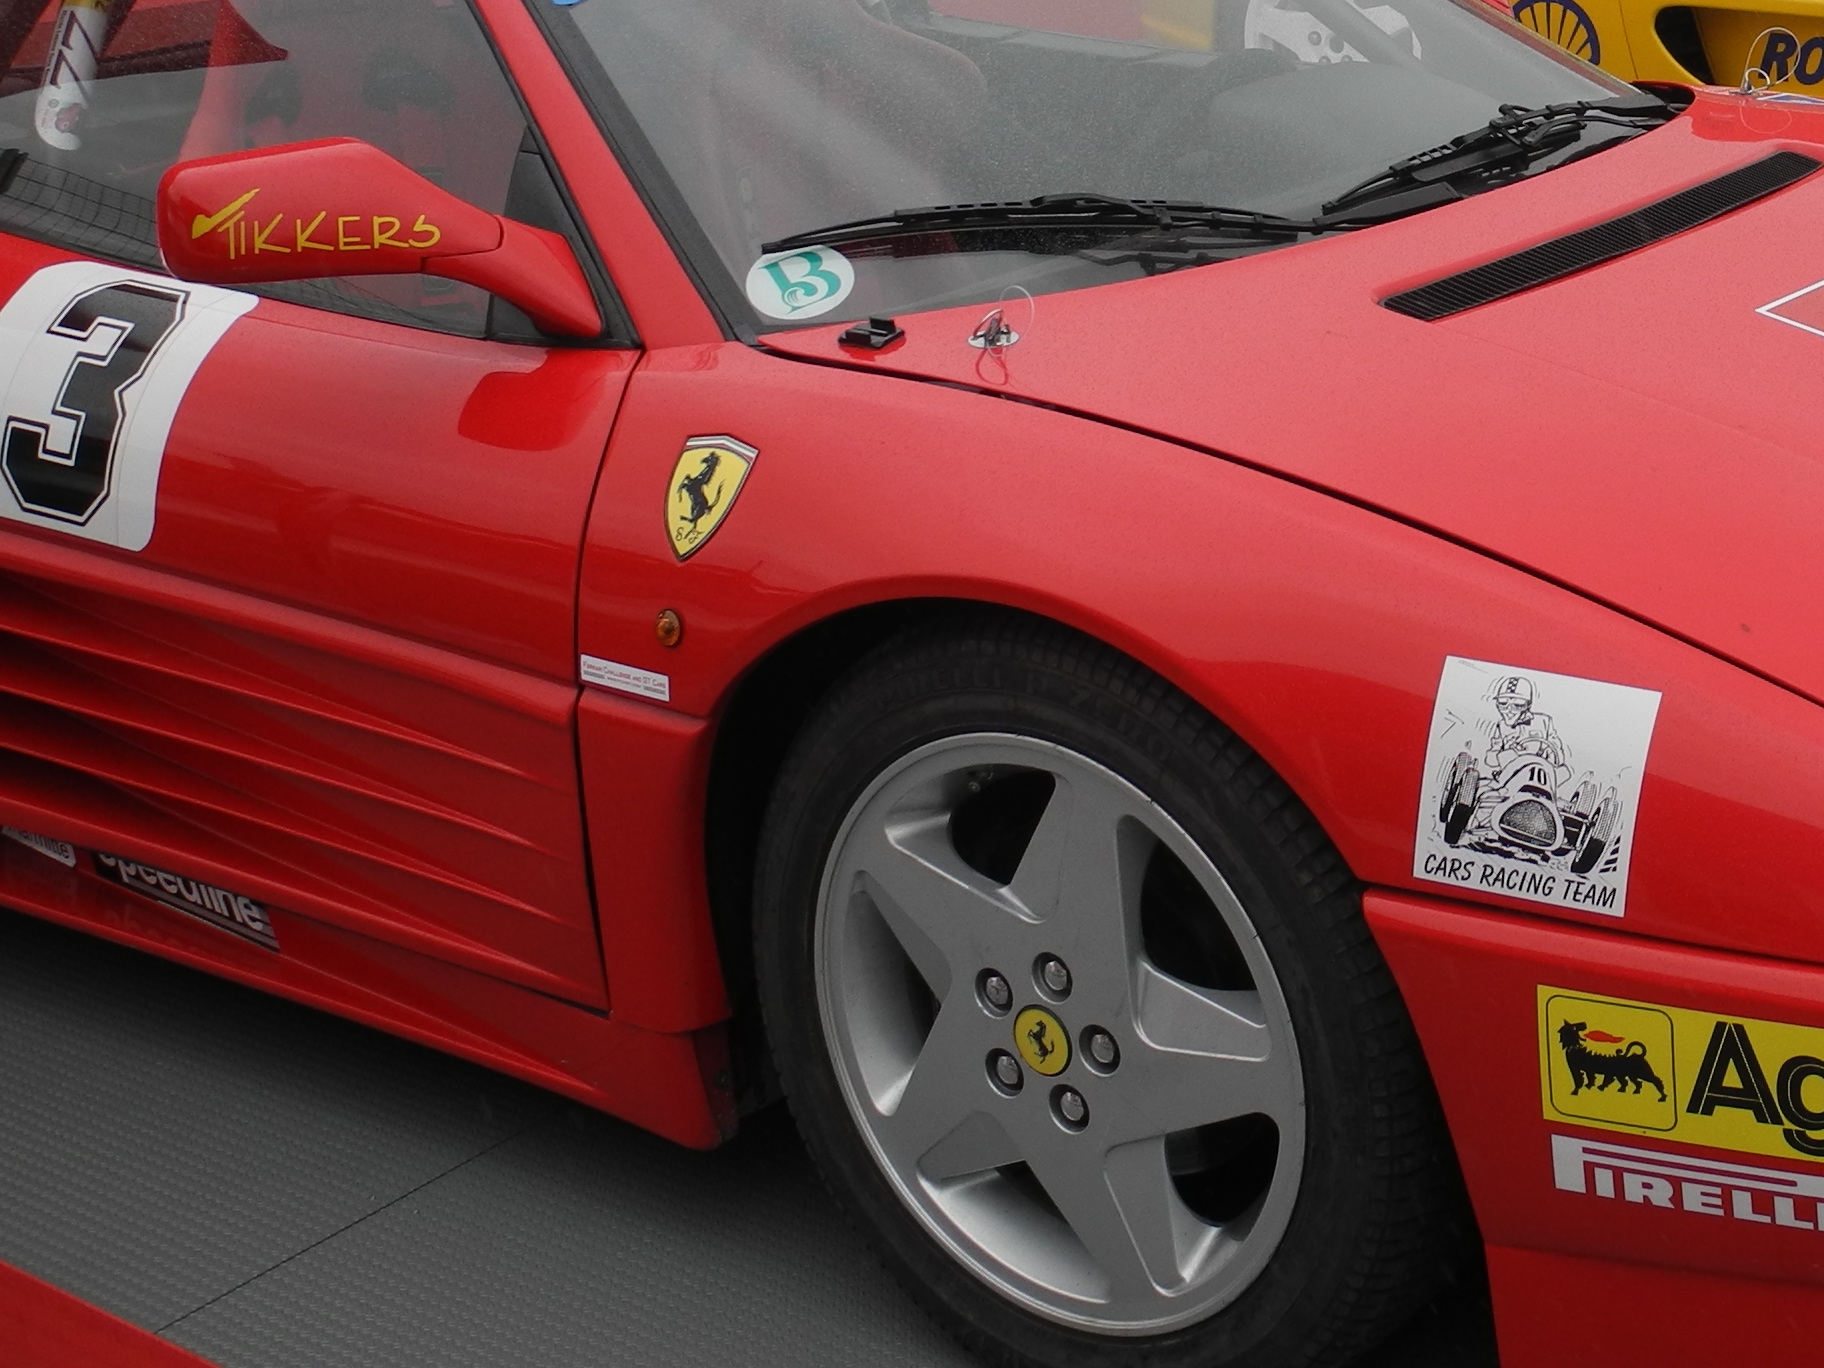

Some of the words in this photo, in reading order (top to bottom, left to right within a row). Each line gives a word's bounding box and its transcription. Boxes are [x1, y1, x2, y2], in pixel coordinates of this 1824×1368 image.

[214, 202, 442, 260] TIKKERS
[1, 280, 190, 526] 3
[1526, 765, 1547, 787] 10
[1423, 852, 1473, 882] CARS
[1479, 864, 1557, 898] RACING
[1562, 879, 1618, 909] TEAM
